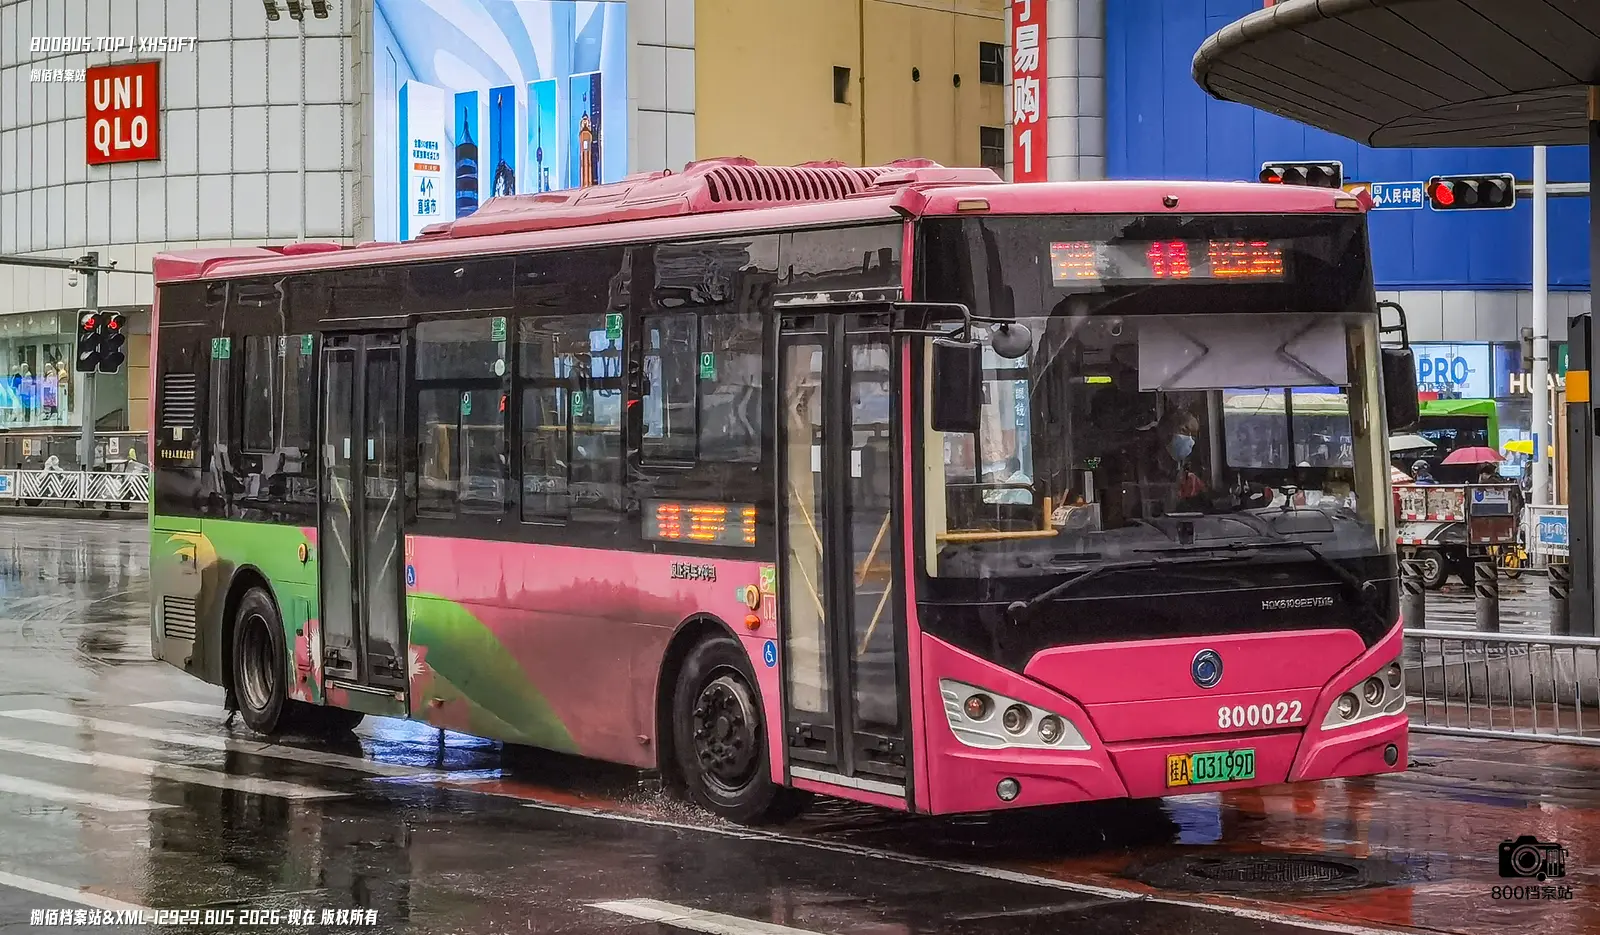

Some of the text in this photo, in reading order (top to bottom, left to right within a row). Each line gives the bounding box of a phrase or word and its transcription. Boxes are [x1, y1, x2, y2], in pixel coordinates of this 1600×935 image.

[94, 75, 143, 111] UNI
[94, 115, 148, 157] QLO
[1383, 187, 1421, 203] 人民中路
[1218, 700, 1303, 728] 800022
